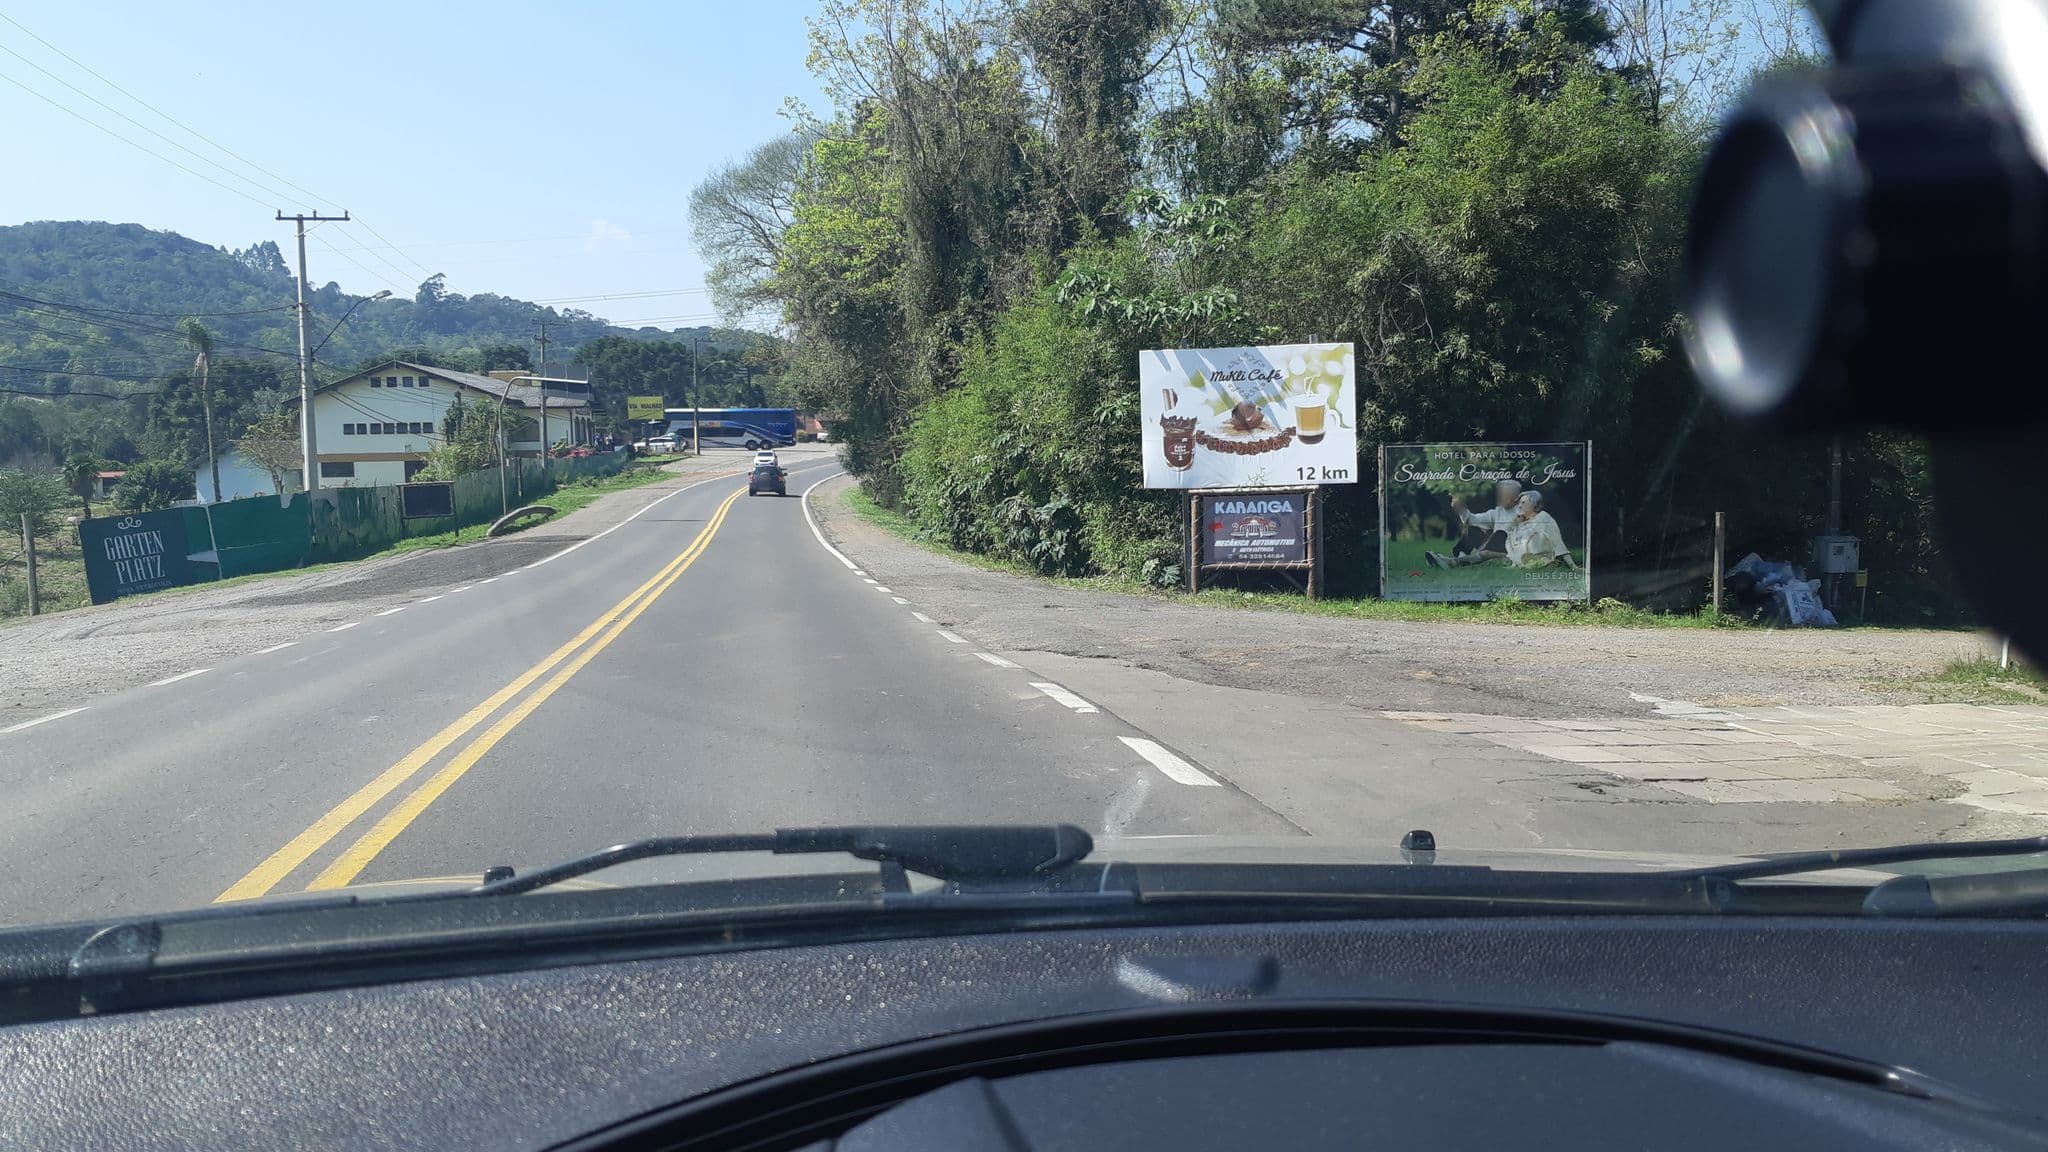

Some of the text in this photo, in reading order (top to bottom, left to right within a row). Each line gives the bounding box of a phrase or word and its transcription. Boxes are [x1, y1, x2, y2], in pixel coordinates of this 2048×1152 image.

[1248, 368, 1284, 382] Café
[1434, 450, 1537, 460] HOTEL PARA IDOSOS
[1296, 465, 1349, 481] 12 km
[1394, 461, 1577, 486] Sagrado Coração de Jesus
[1214, 500, 1293, 515] KARANGA
[104, 530, 164, 560] GARTEN
[115, 555, 165, 584] PLATZ
[1525, 572, 1550, 580] DEUS
